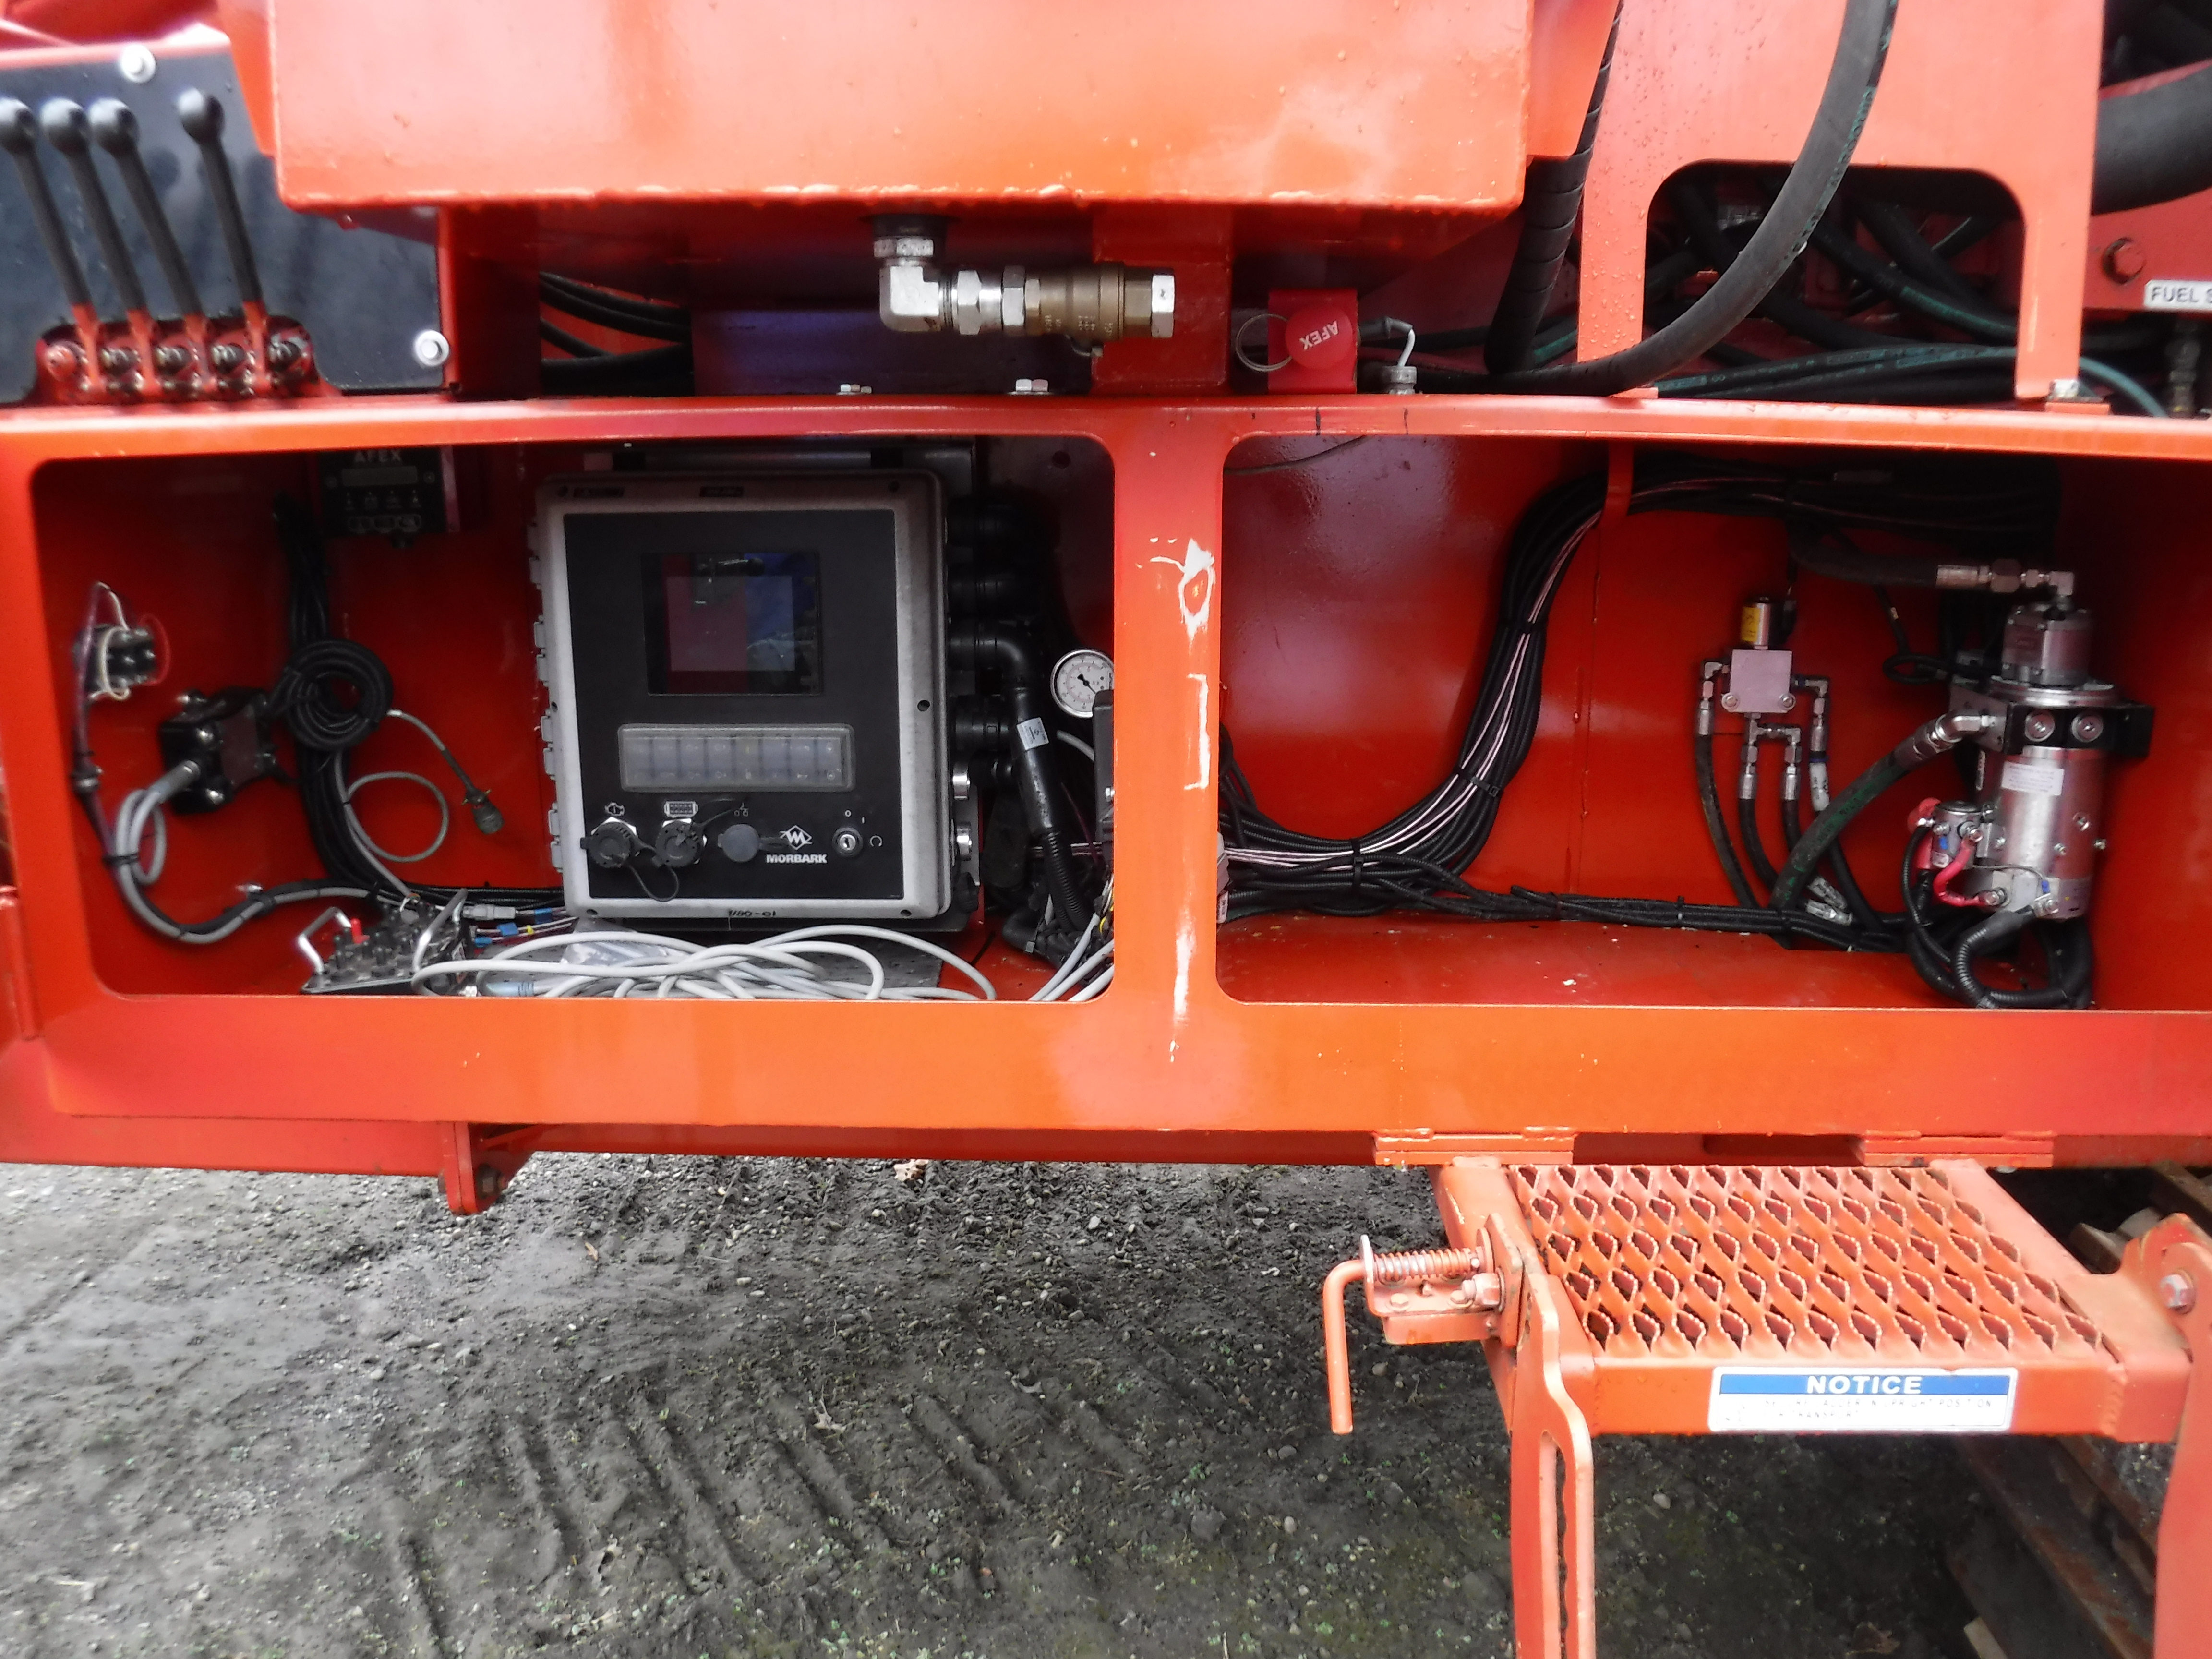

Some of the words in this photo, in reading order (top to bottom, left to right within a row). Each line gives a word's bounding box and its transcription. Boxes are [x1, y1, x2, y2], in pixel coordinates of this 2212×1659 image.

[2152, 287, 2199, 302] FUEL
[1299, 321, 1338, 350] AFEX
[766, 854, 827, 863] MORBARK
[1807, 1376, 1922, 1394] NOTICE
[1815, 1398, 1861, 1407] ADDER
[1883, 1399, 1934, 1407] PRGH
[1939, 1399, 1991, 1407] POSON
[1791, 1409, 1861, 1419] RANSPOR
